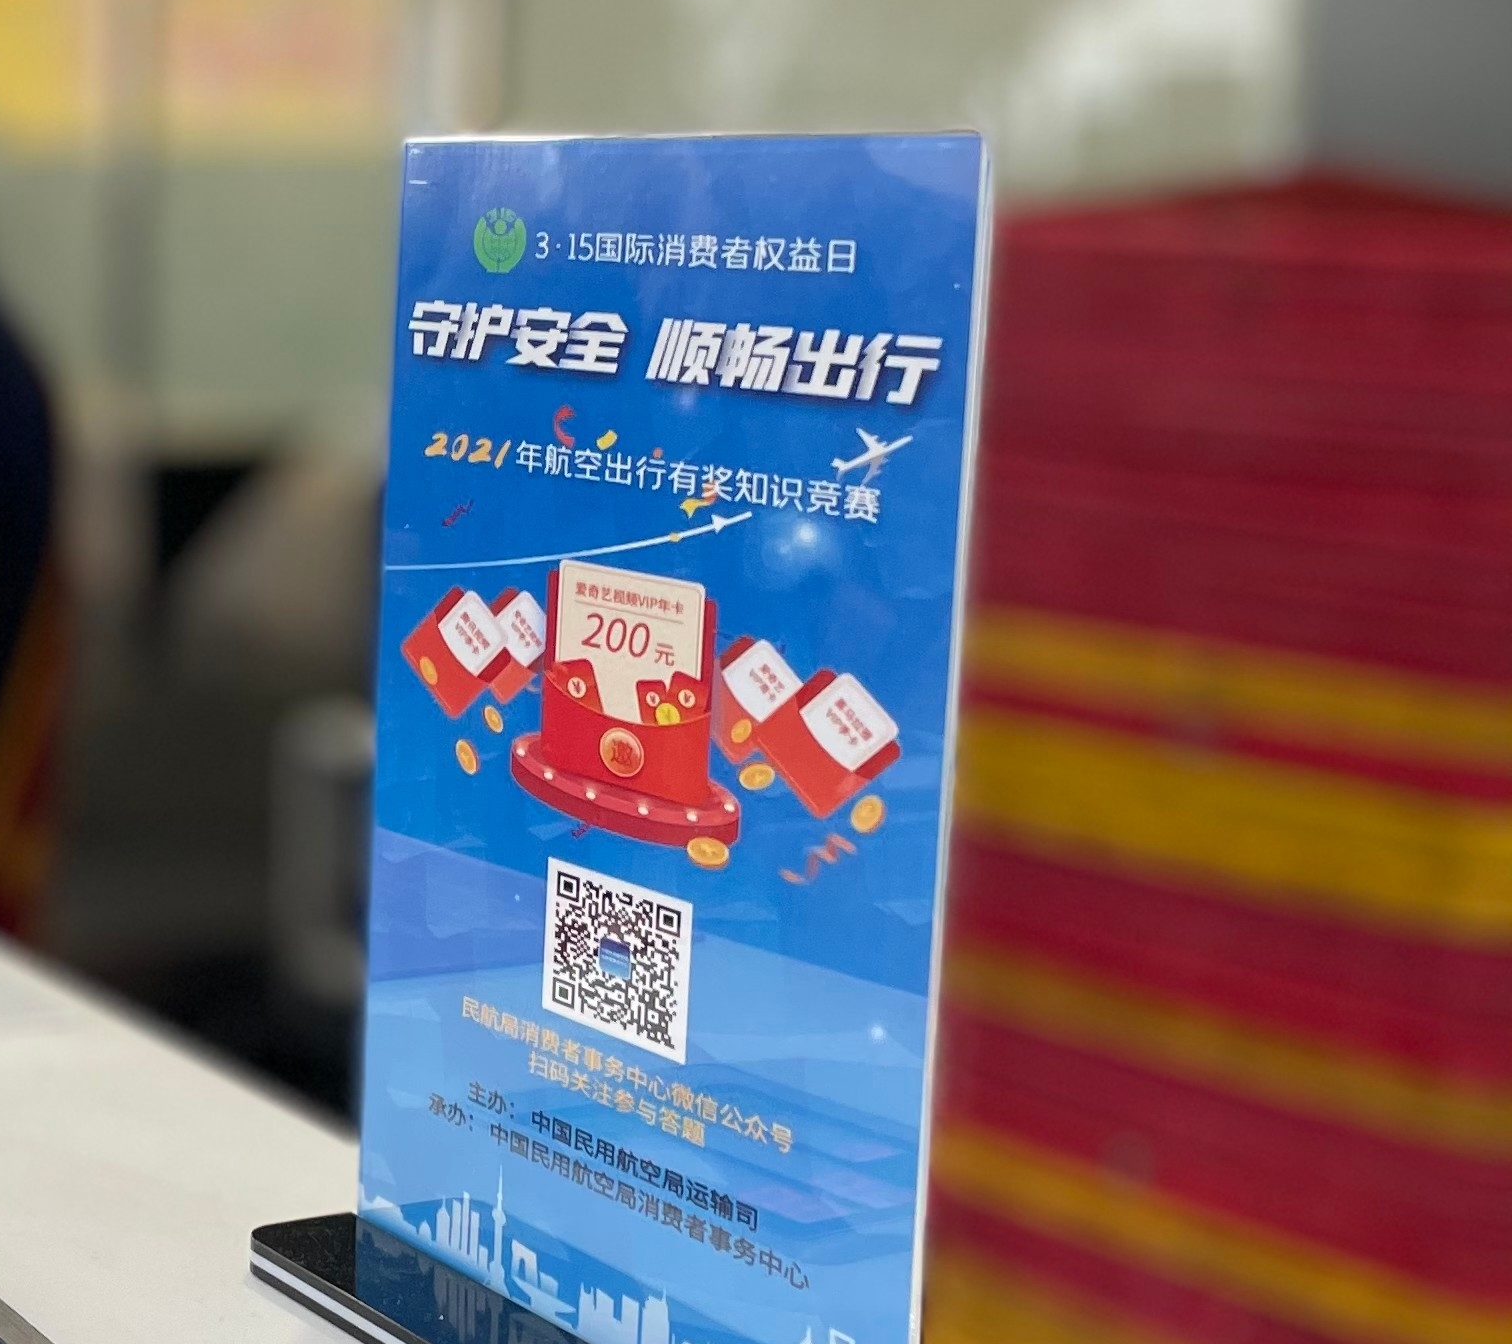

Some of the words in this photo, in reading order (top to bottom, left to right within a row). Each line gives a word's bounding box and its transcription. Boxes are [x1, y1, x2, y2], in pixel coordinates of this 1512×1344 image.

[407, 299, 630, 375] 守护安全
[645, 316, 943, 406] 顺畅出行
[575, 581, 684, 615] 爱奇艺视频VIP年卡
[461, 995, 794, 1154] 民航局消费者事务中心微信公众号
[529, 1050, 706, 1148] 扫码关注参与答题
